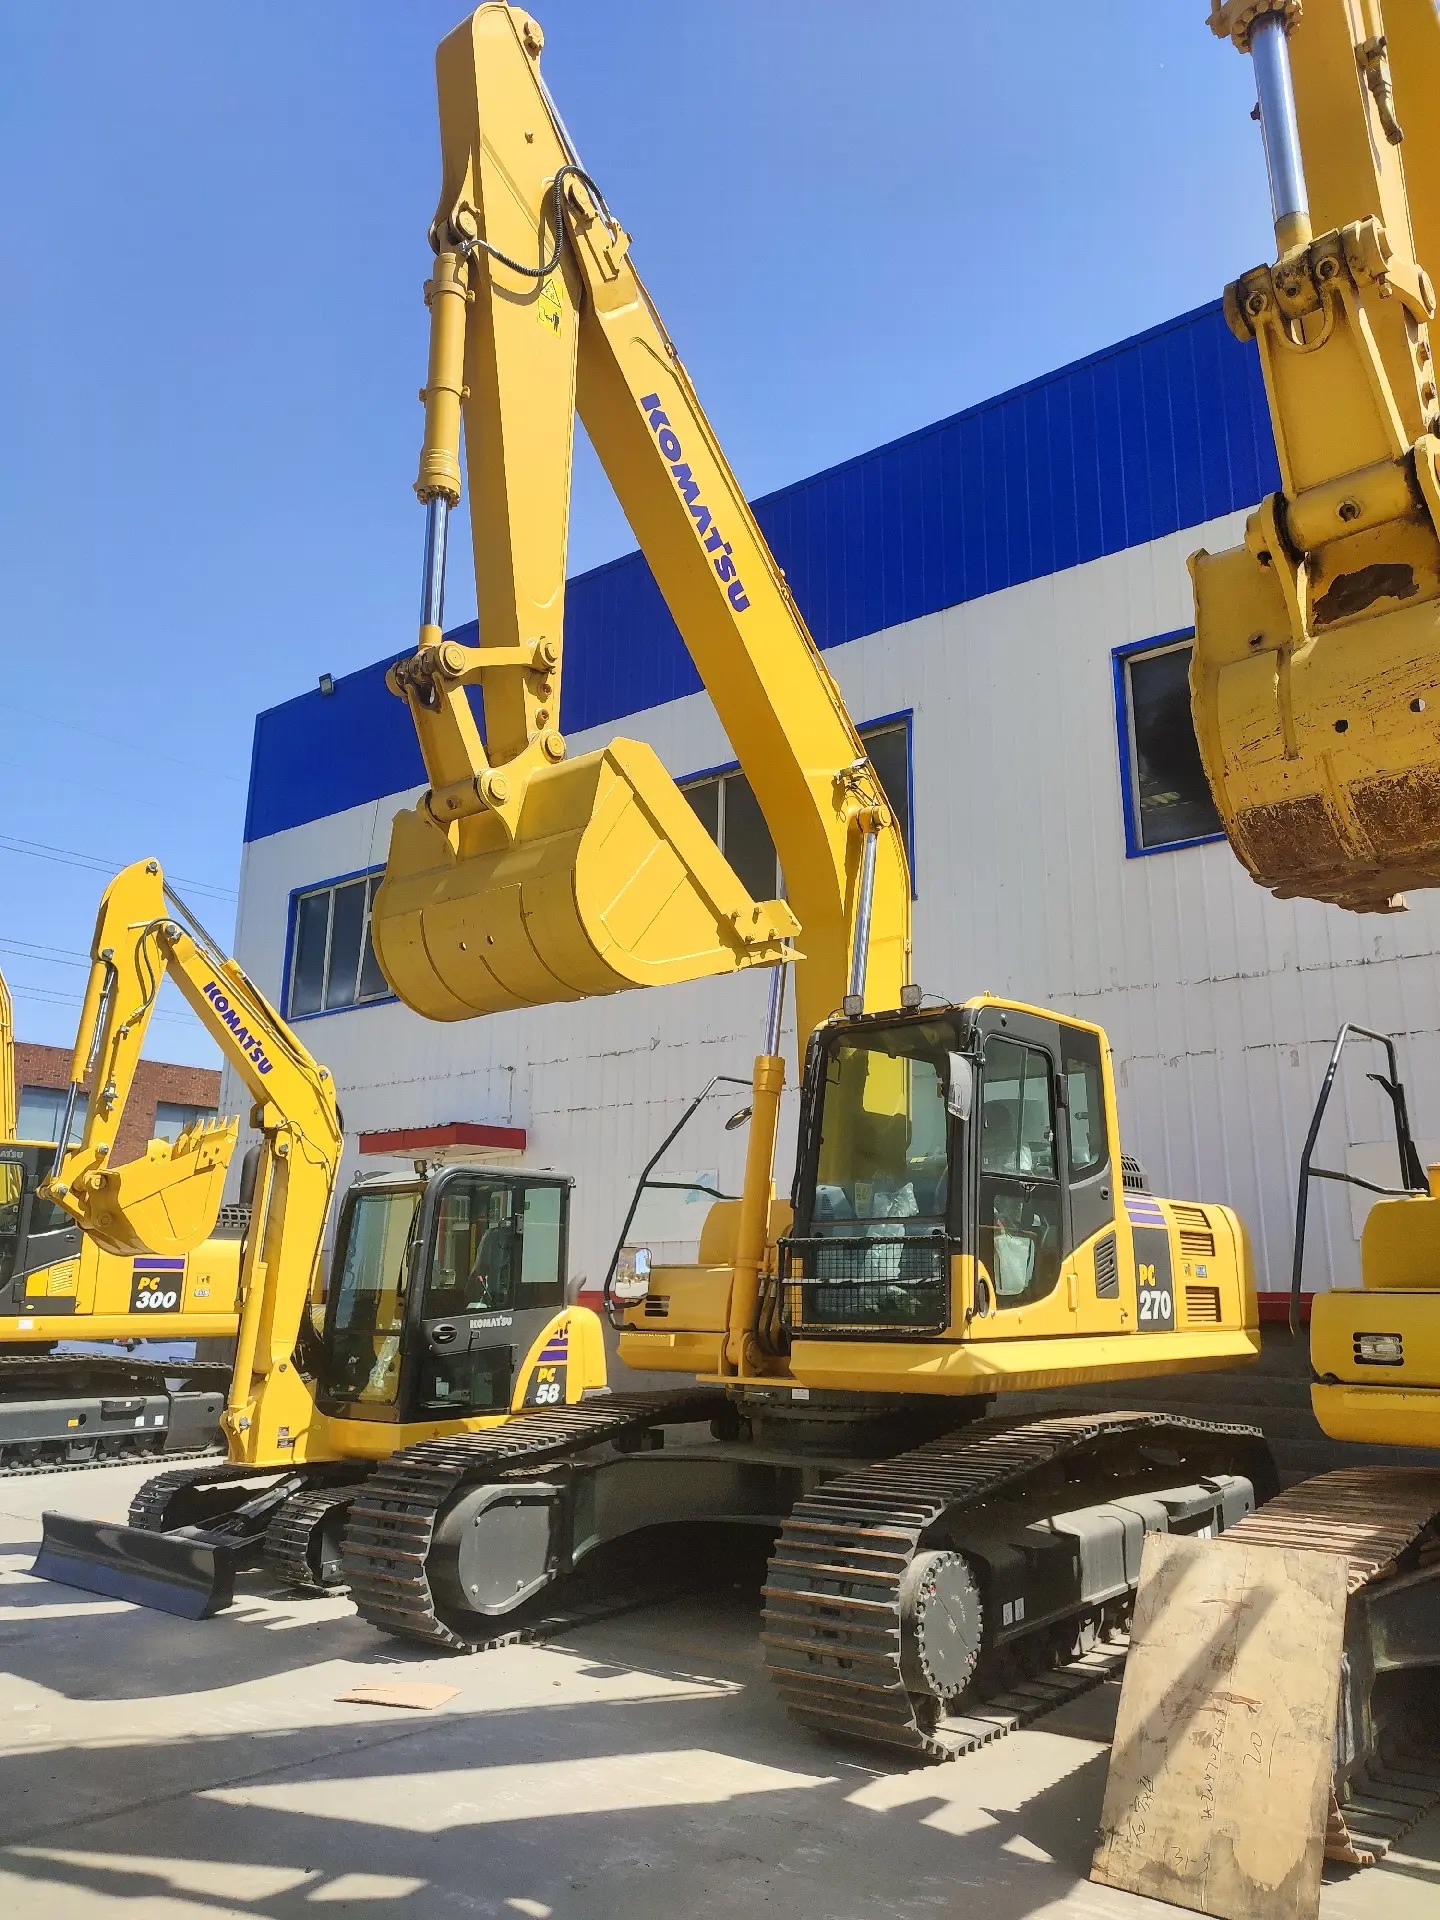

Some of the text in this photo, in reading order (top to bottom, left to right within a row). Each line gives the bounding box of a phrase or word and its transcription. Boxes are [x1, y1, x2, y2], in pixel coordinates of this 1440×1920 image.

[640, 393, 750, 613] KOMATSU
[203, 981, 274, 1075] KOMATSU
[137, 1276, 160, 1290] PC
[1138, 1263, 1156, 1287] PC
[135, 1291, 177, 1308] 300
[1140, 1290, 1171, 1320] 270
[469, 1315, 513, 1329] KOMATSU
[537, 1367, 556, 1382] PC
[535, 1383, 560, 1404] 58
